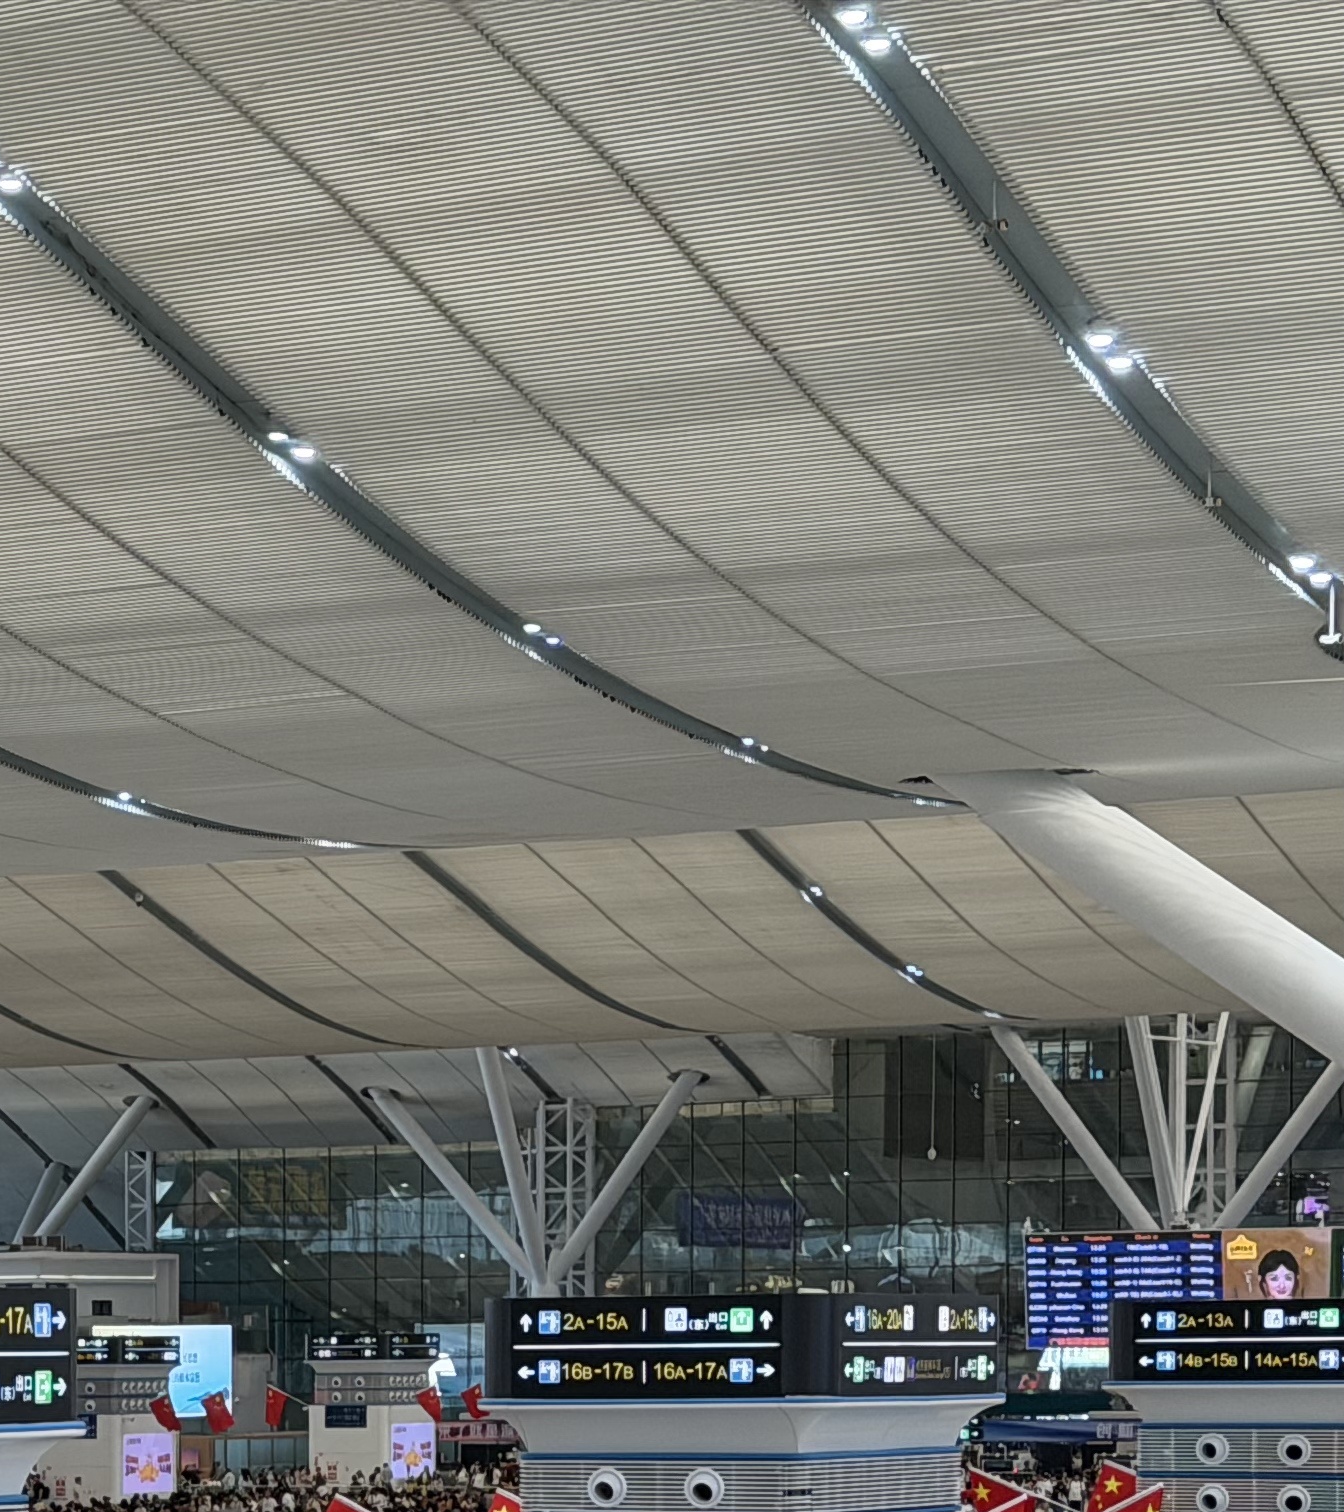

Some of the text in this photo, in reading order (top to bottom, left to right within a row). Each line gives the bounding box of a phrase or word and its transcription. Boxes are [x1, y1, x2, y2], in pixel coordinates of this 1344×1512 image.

[563, 1312, 629, 1331] 2A-15A
[1178, 1313, 1234, 1329] 2A-13A
[1177, 1352, 1318, 1368] 14B-15B 14A-15A
[561, 1362, 728, 1381] 16B-17B 16A-17A
